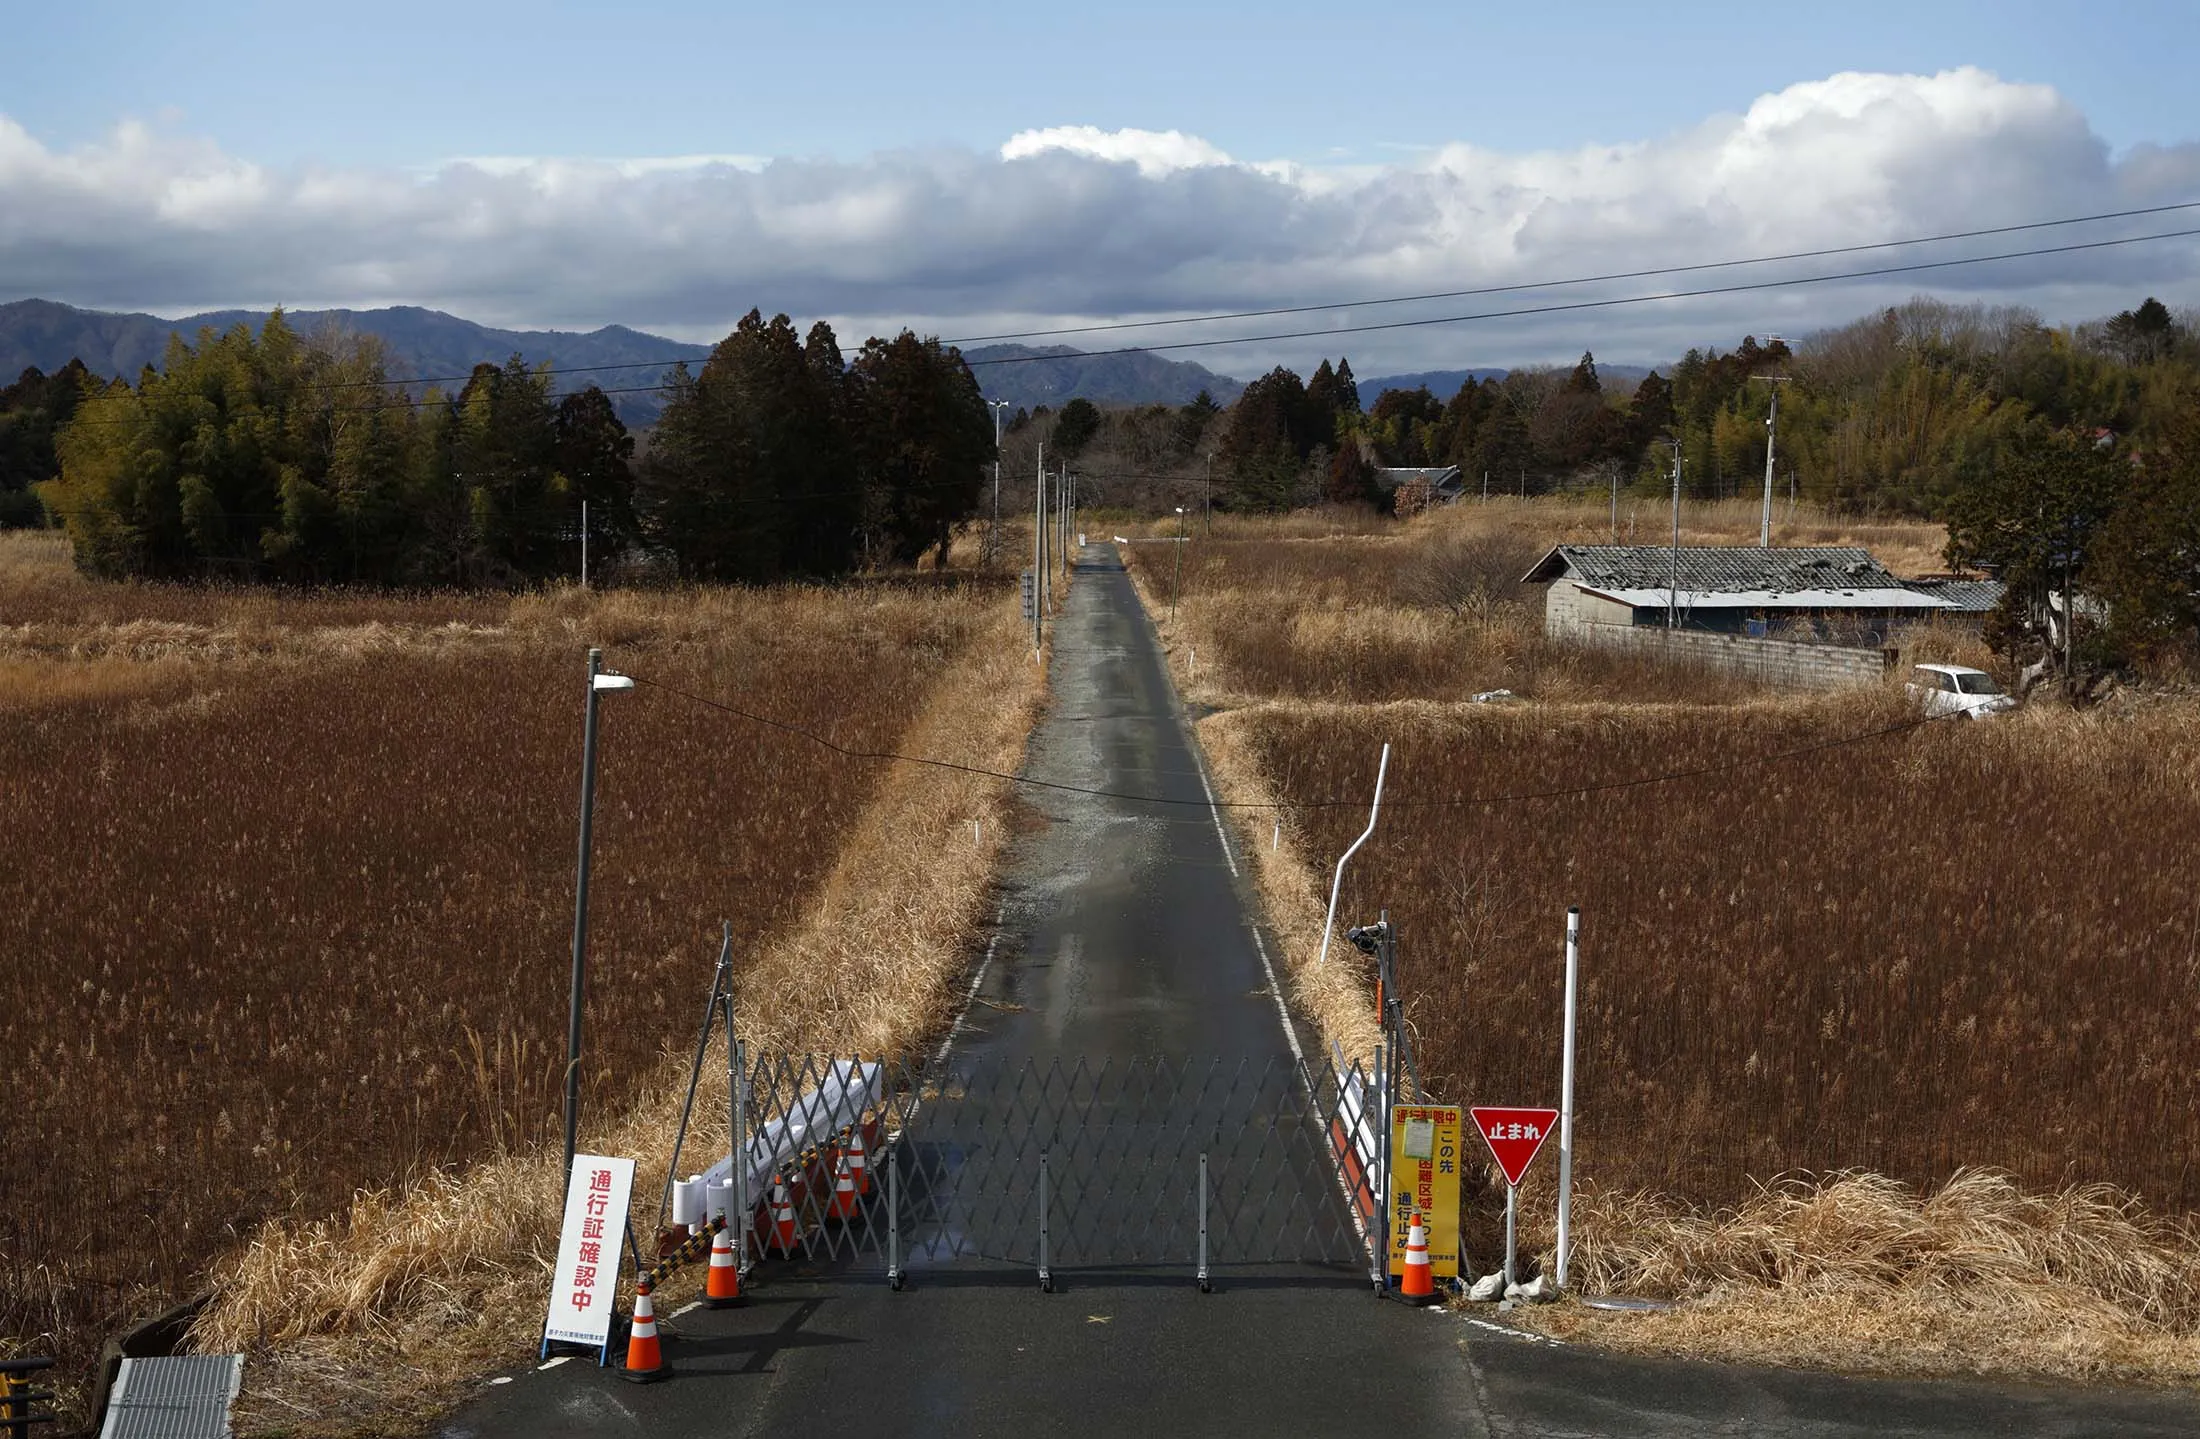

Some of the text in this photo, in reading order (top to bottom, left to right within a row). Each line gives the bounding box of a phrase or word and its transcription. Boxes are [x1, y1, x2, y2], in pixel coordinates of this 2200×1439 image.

[1440, 1130, 1454, 1174] この先
[1489, 1122, 1541, 1140] 止まれ
[571, 1169, 612, 1312] 通行証確認中
[1397, 1192, 1412, 1248] 通行止め
